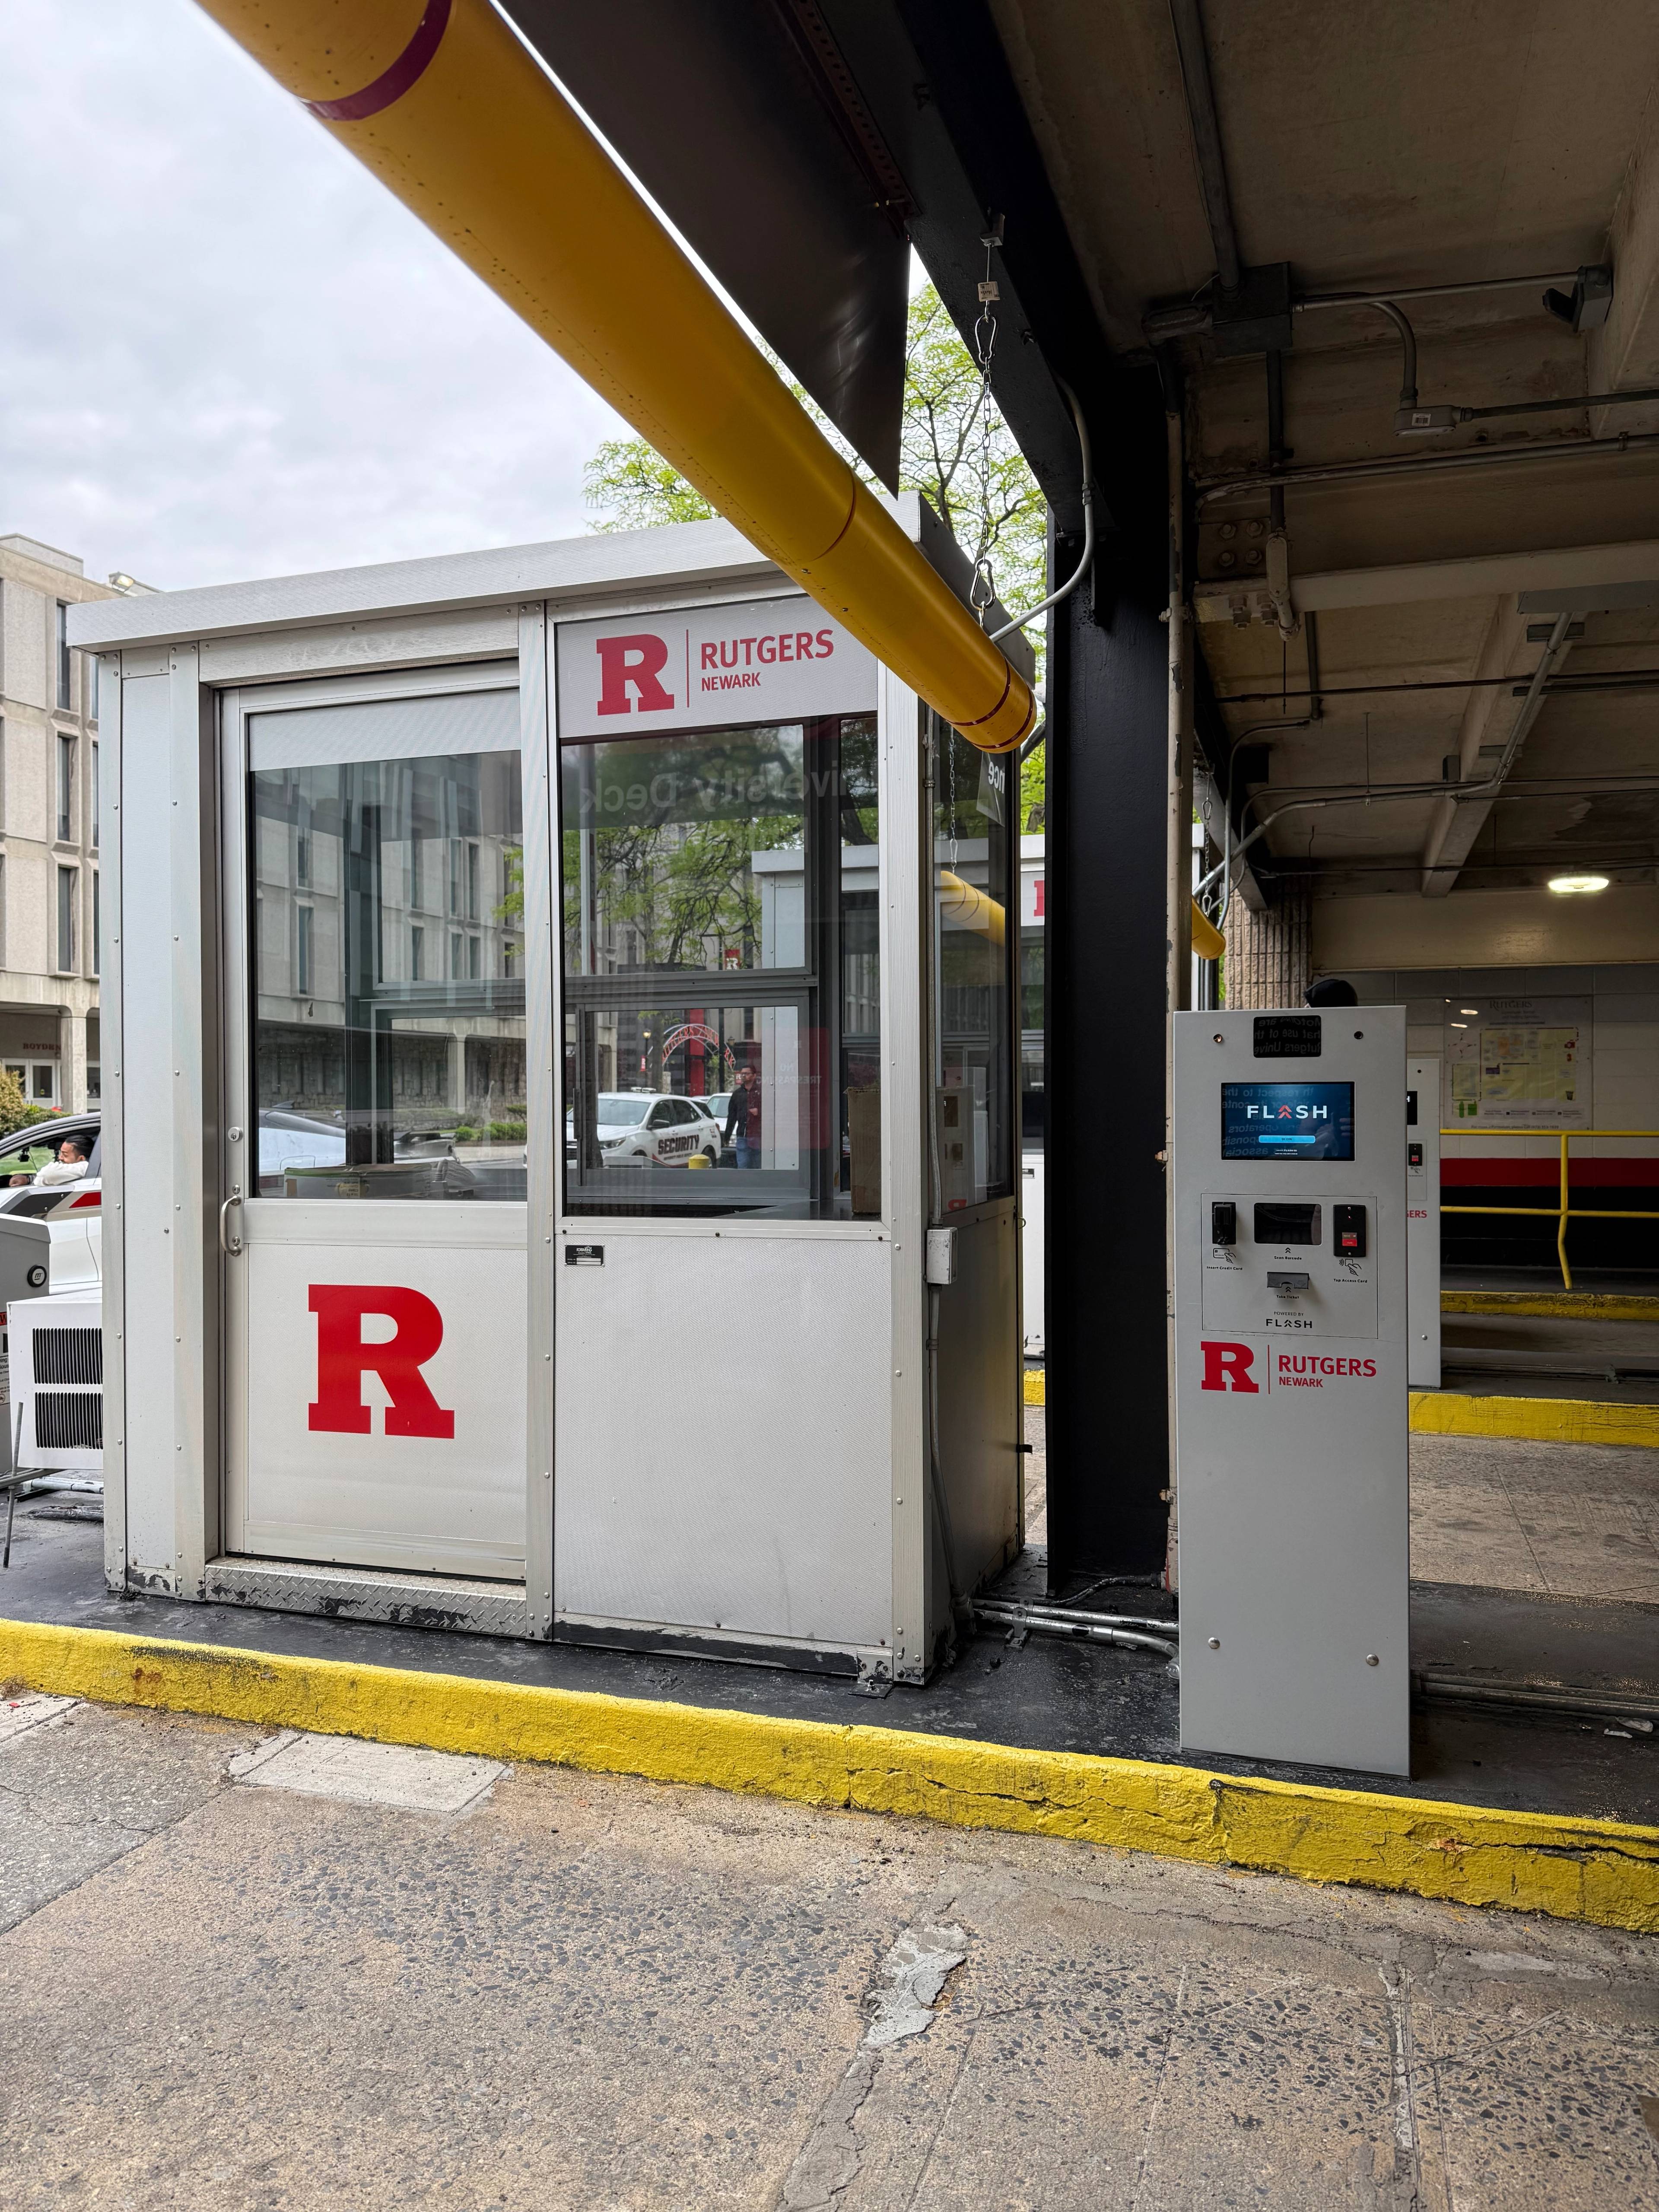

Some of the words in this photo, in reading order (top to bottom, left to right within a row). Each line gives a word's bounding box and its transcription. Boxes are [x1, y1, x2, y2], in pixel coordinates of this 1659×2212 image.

[701, 629, 834, 670] RUTGERS
[596, 634, 674, 716] R
[702, 672, 761, 691] NEWARK
[1247, 1105, 1327, 1119] FLASH
[658, 1135, 699, 1155] SECURITY
[1266, 1319, 1313, 1328] FLASH
[308, 1284, 454, 1439] R
[1201, 1341, 1259, 1393] R
[1279, 1355, 1376, 1377] RUTGERS
[1279, 1376, 1323, 1388] NEWARK
